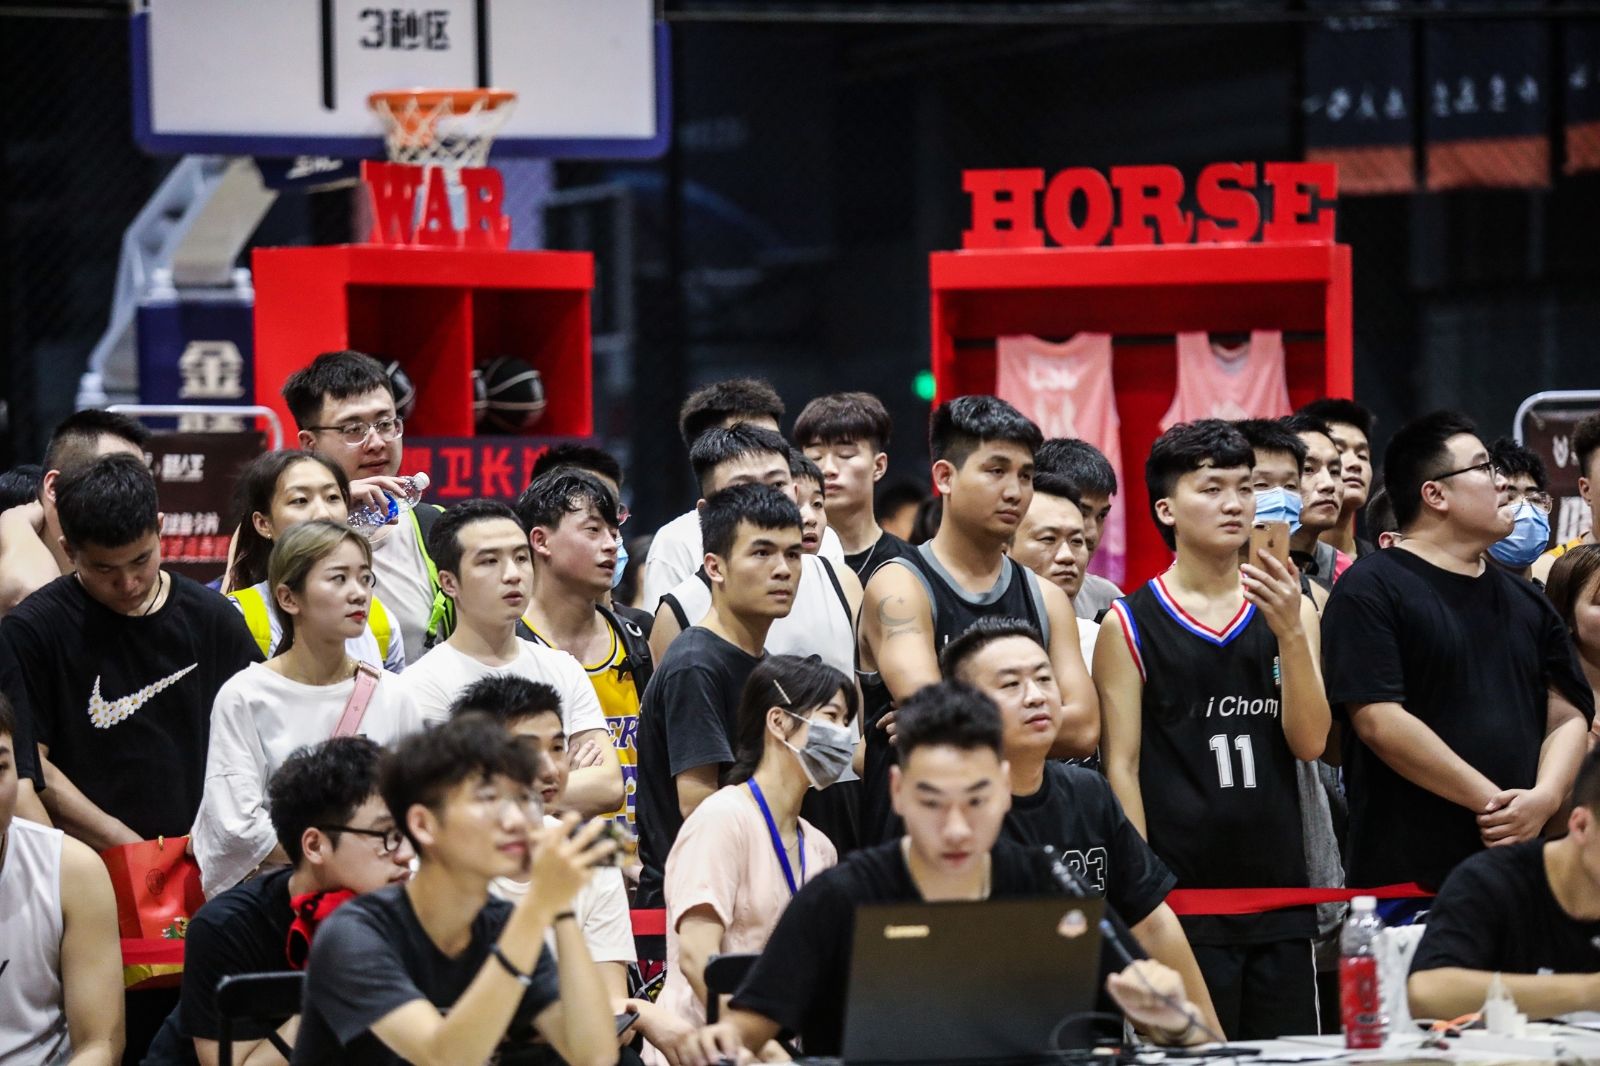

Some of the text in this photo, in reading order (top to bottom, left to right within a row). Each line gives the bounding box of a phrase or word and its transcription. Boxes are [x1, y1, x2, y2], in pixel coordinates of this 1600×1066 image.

[359, 7, 450, 50] 3秒区
[361, 159, 512, 249] WAR
[961, 161, 1338, 249] HORSE
[1209, 733, 1257, 788] 11
